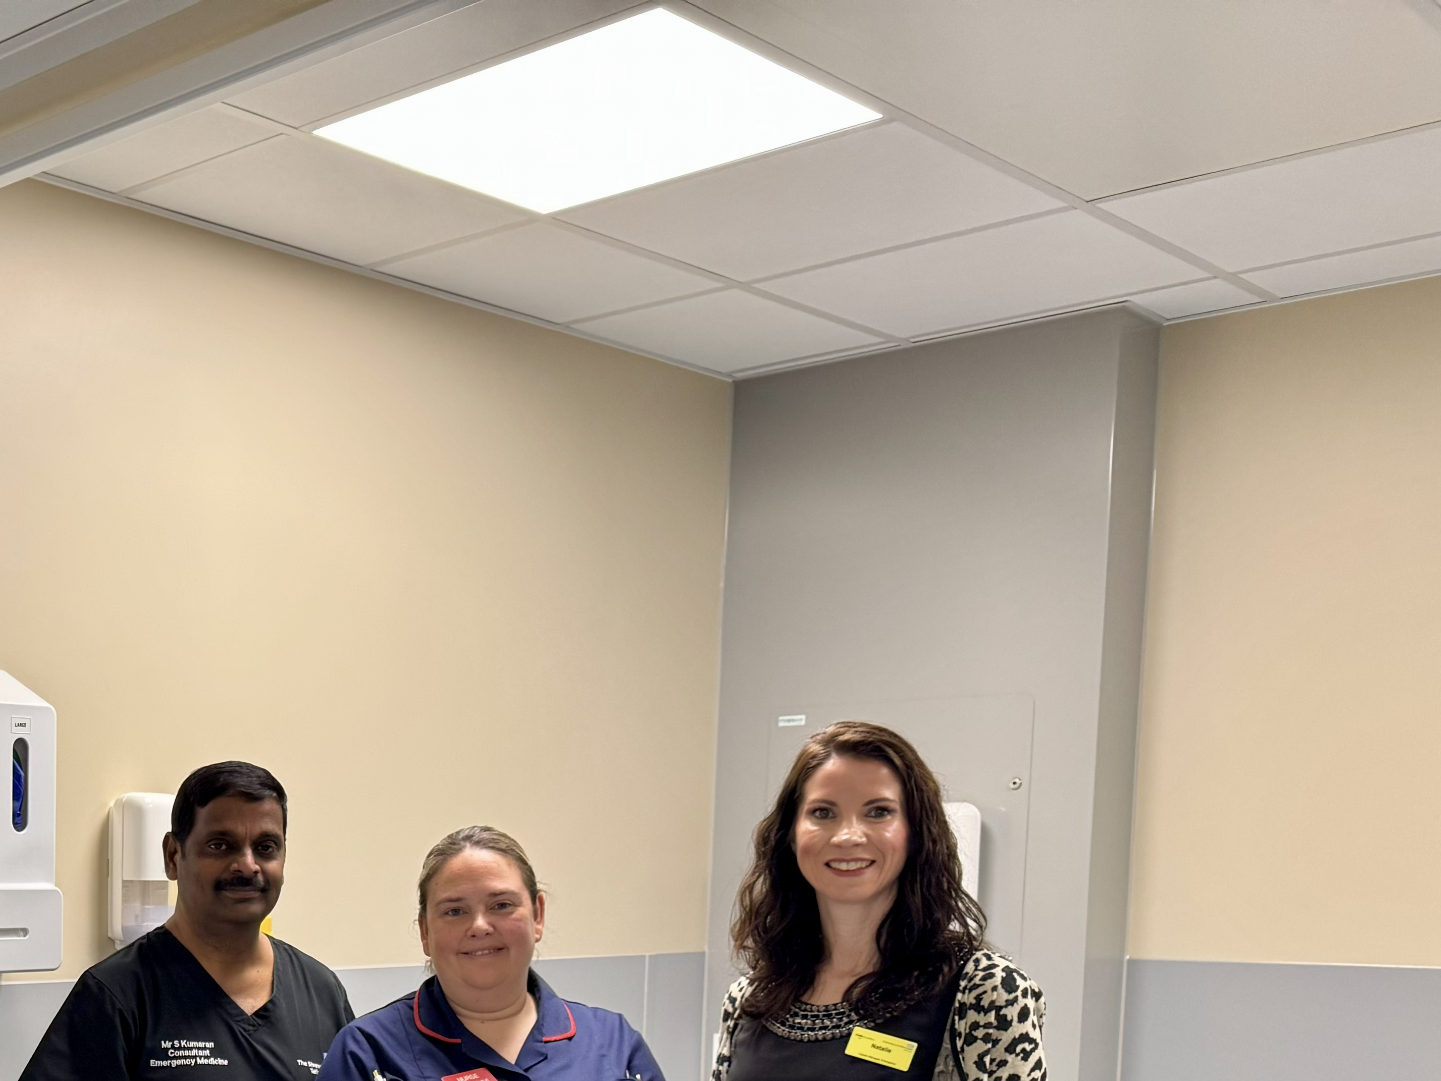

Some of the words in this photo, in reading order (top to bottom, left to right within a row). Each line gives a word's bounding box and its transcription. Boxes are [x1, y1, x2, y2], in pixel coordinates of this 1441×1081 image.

[161, 1040, 172, 1049] Mr
[173, 1040, 180, 1048] S
[180, 1039, 215, 1048] Kumaran
[167, 1048, 211, 1057] Consultant
[149, 1057, 196, 1068] Emergency
[196, 1056, 229, 1066] Medicine
